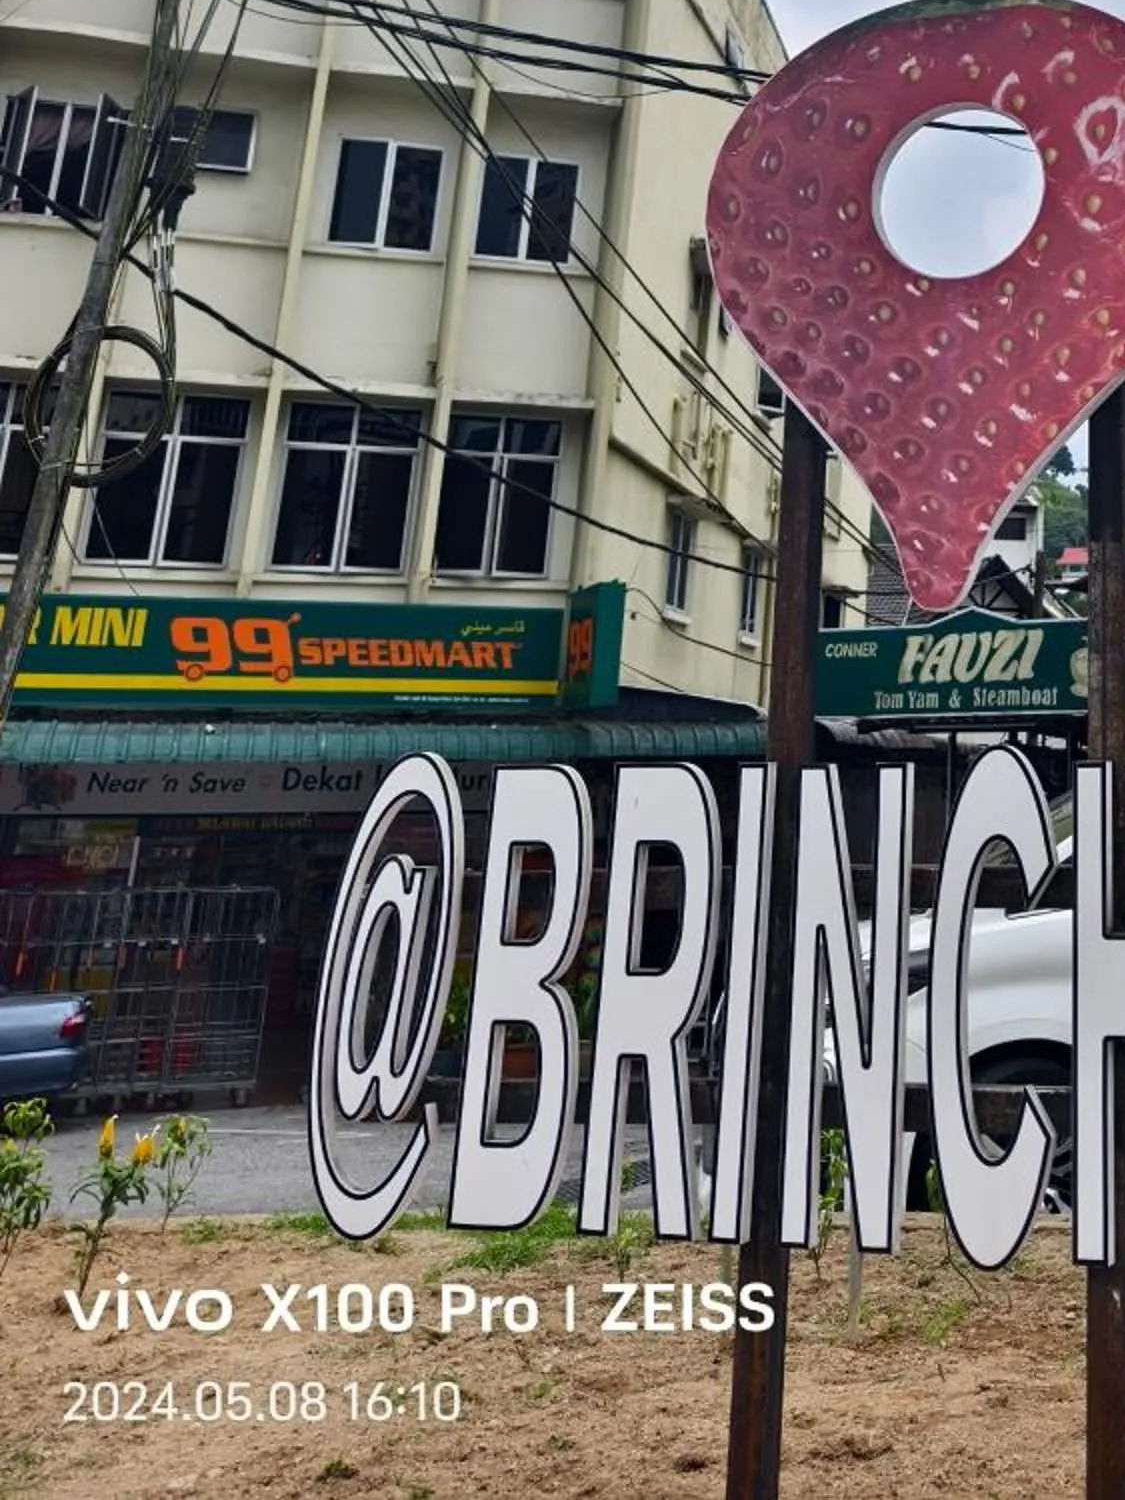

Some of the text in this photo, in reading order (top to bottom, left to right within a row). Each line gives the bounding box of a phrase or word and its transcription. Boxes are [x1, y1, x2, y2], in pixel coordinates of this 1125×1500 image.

[50, 605, 148, 647] MINI
[170, 614, 516, 682] 99 SPEEDMART
[897, 627, 1044, 685] FAUZI
[874, 686, 1058, 710] Tom Yam & Steamboat
[87, 771, 149, 794] Near
[161, 774, 179, 793] 'n
[189, 772, 247, 794] Save
[282, 767, 362, 792] Dekat
